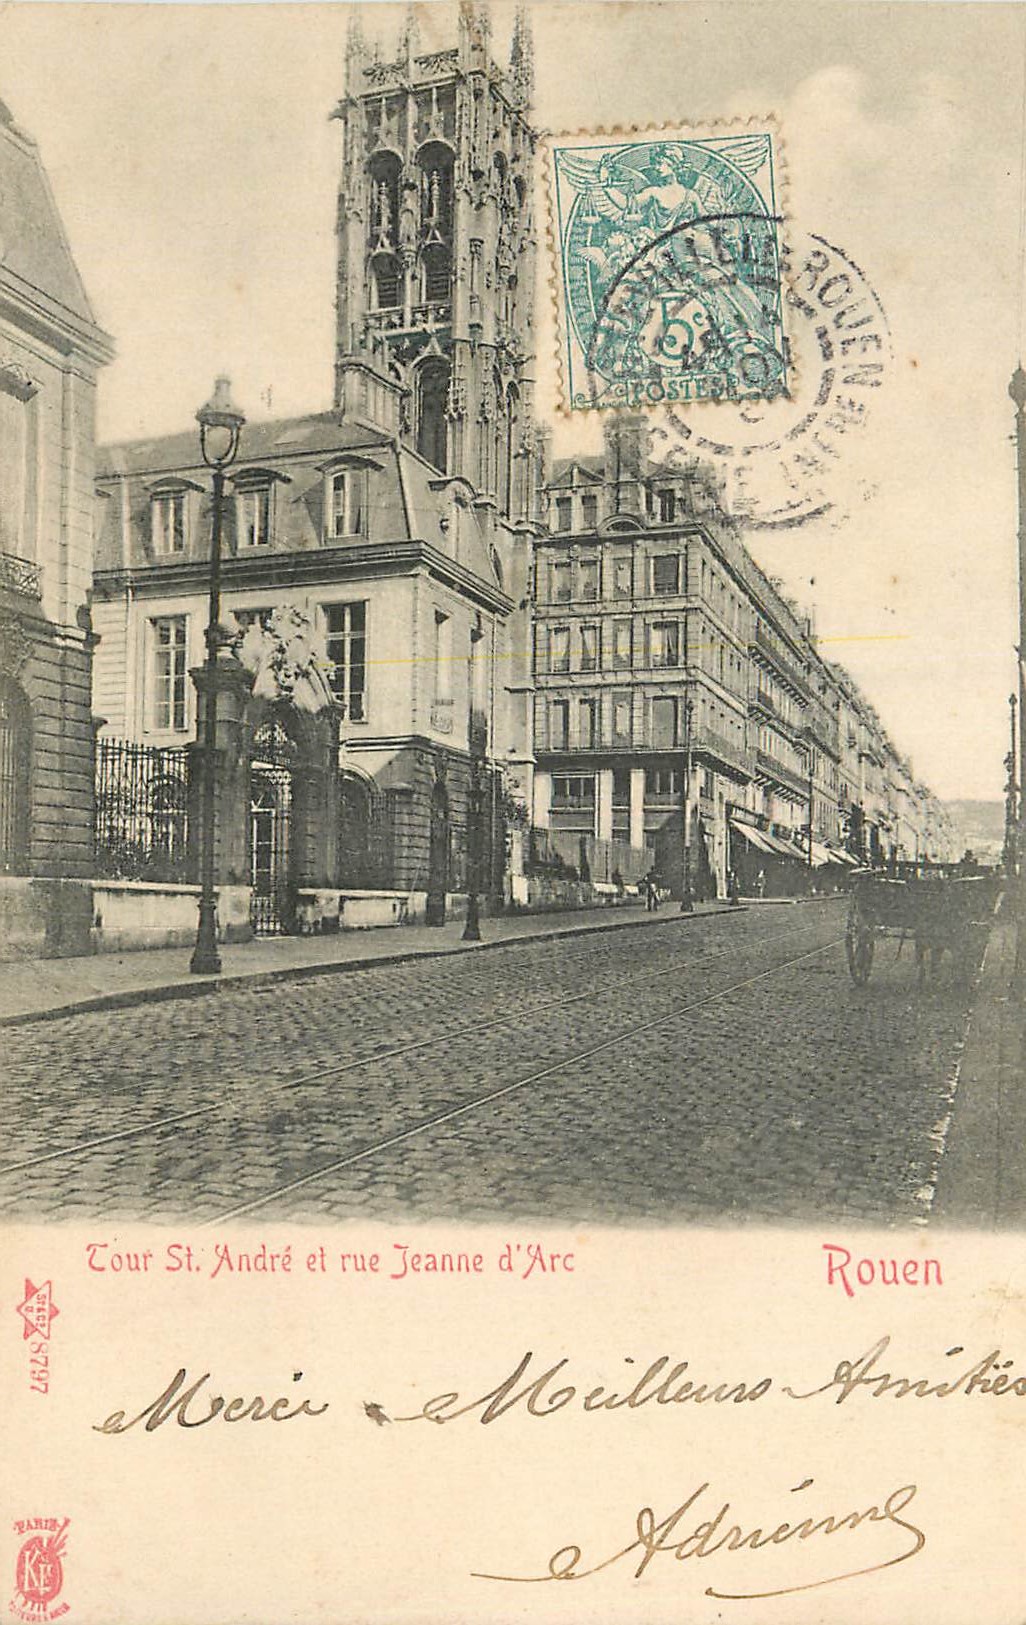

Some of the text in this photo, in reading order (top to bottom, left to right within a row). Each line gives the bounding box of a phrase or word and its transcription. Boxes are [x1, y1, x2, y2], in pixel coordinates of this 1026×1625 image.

[802, 250, 884, 387] ROUEN
[628, 376, 724, 402] POSTES
[92, 1368, 329, 1434] Merci
